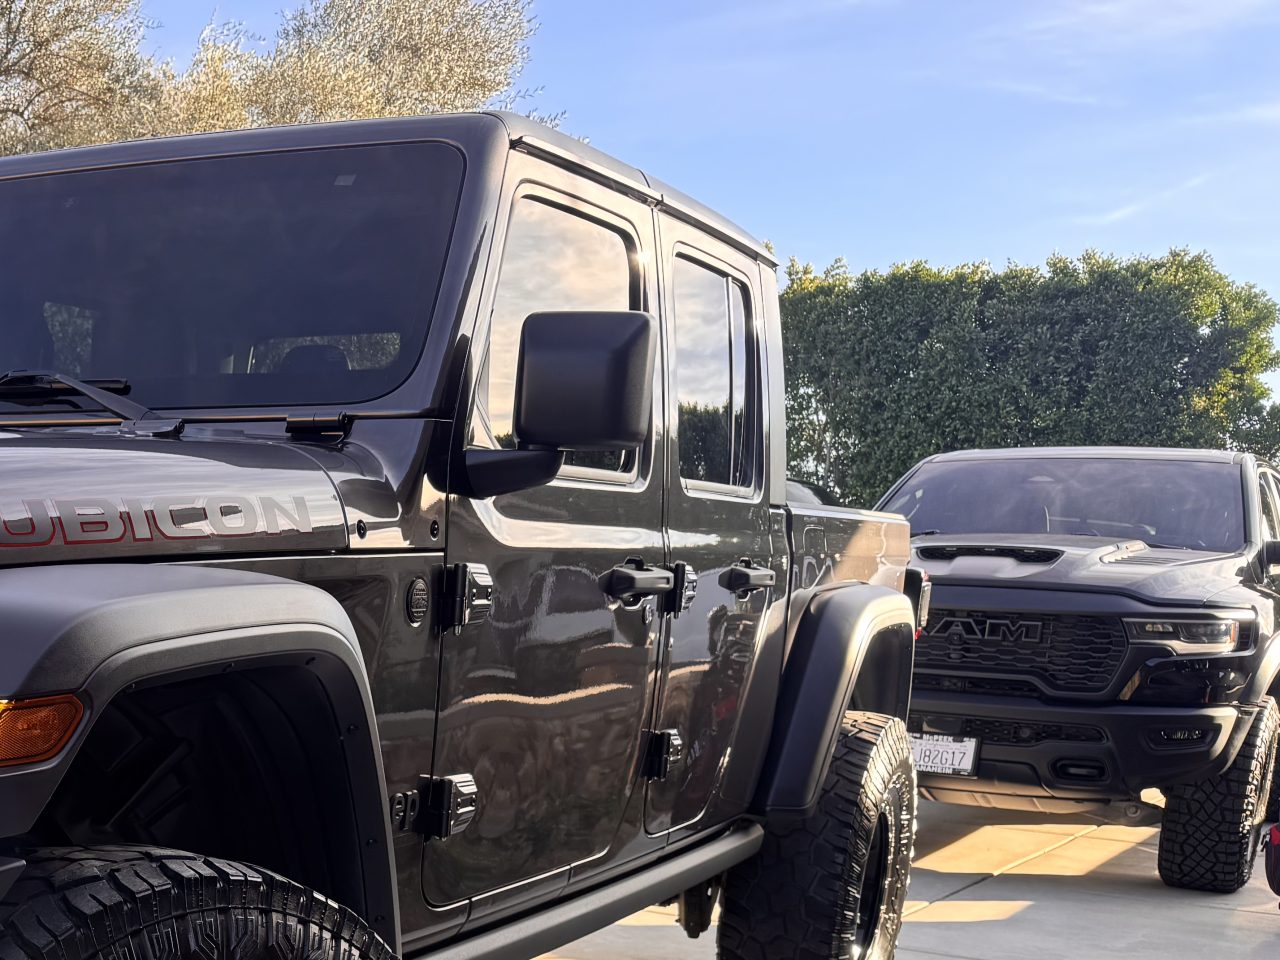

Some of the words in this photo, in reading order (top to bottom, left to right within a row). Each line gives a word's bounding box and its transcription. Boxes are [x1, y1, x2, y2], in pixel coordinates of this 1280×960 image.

[930, 617, 1042, 641] AM
[913, 748, 967, 767] J82G17
[915, 764, 953, 775] ANAHEIM
